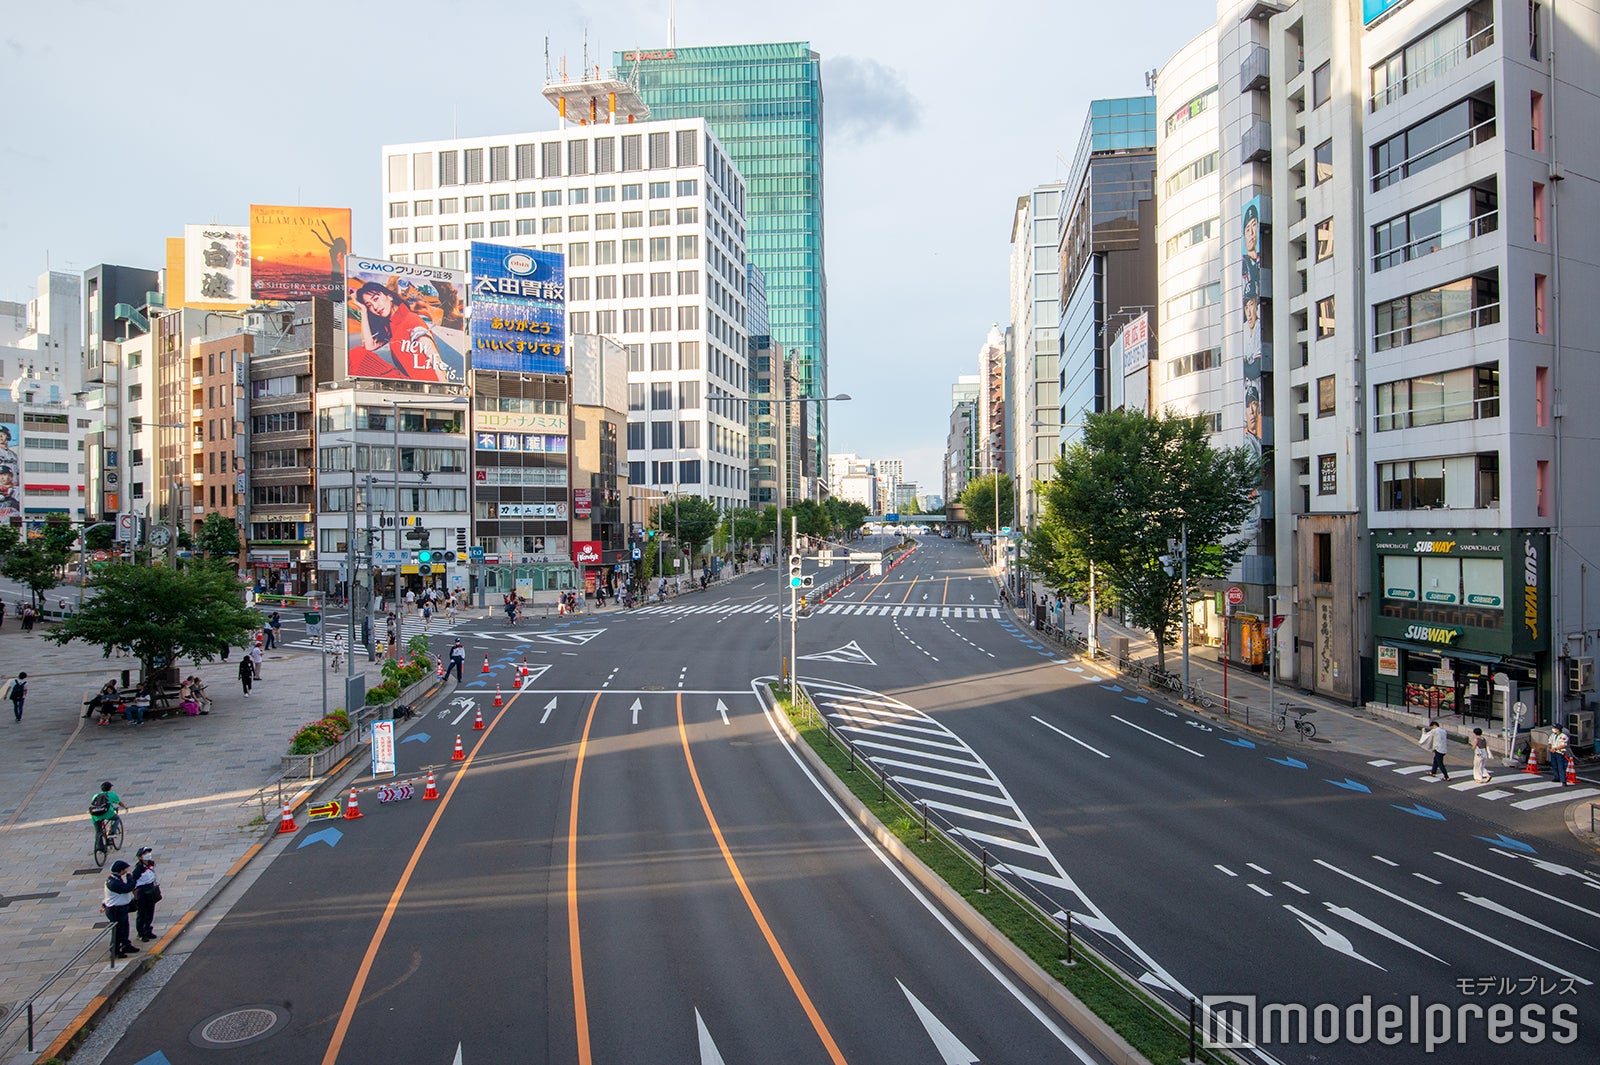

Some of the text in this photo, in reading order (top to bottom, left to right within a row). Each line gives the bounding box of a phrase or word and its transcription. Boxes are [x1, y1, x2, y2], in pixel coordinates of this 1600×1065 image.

[623, 50, 675, 61] ORACLE
[255, 216, 321, 227] ALLAMANDA
[358, 261, 453, 280] GMOクリック証券
[266, 280, 307, 290] SHIGIRA
[473, 274, 565, 300] 太田胃散
[491, 317, 551, 335] ありがとう
[400, 339, 428, 355] new
[477, 337, 563, 356] いいくすりです
[413, 353, 449, 370] Life
[477, 415, 567, 429] コロナ・ナノミスト
[479, 433, 541, 451] 不動産
[380, 516, 422, 527] DOTOR
[1413, 541, 1457, 553] SUBWAY
[375, 551, 409, 559] 外苑前
[1391, 589, 1411, 597] SUBWAY
[1430, 593, 1451, 601] SUBWAY
[1524, 539, 1538, 641] SUBWAY
[1472, 596, 1495, 604] SUBWAY
[1404, 624, 1458, 644] SUBWAY
